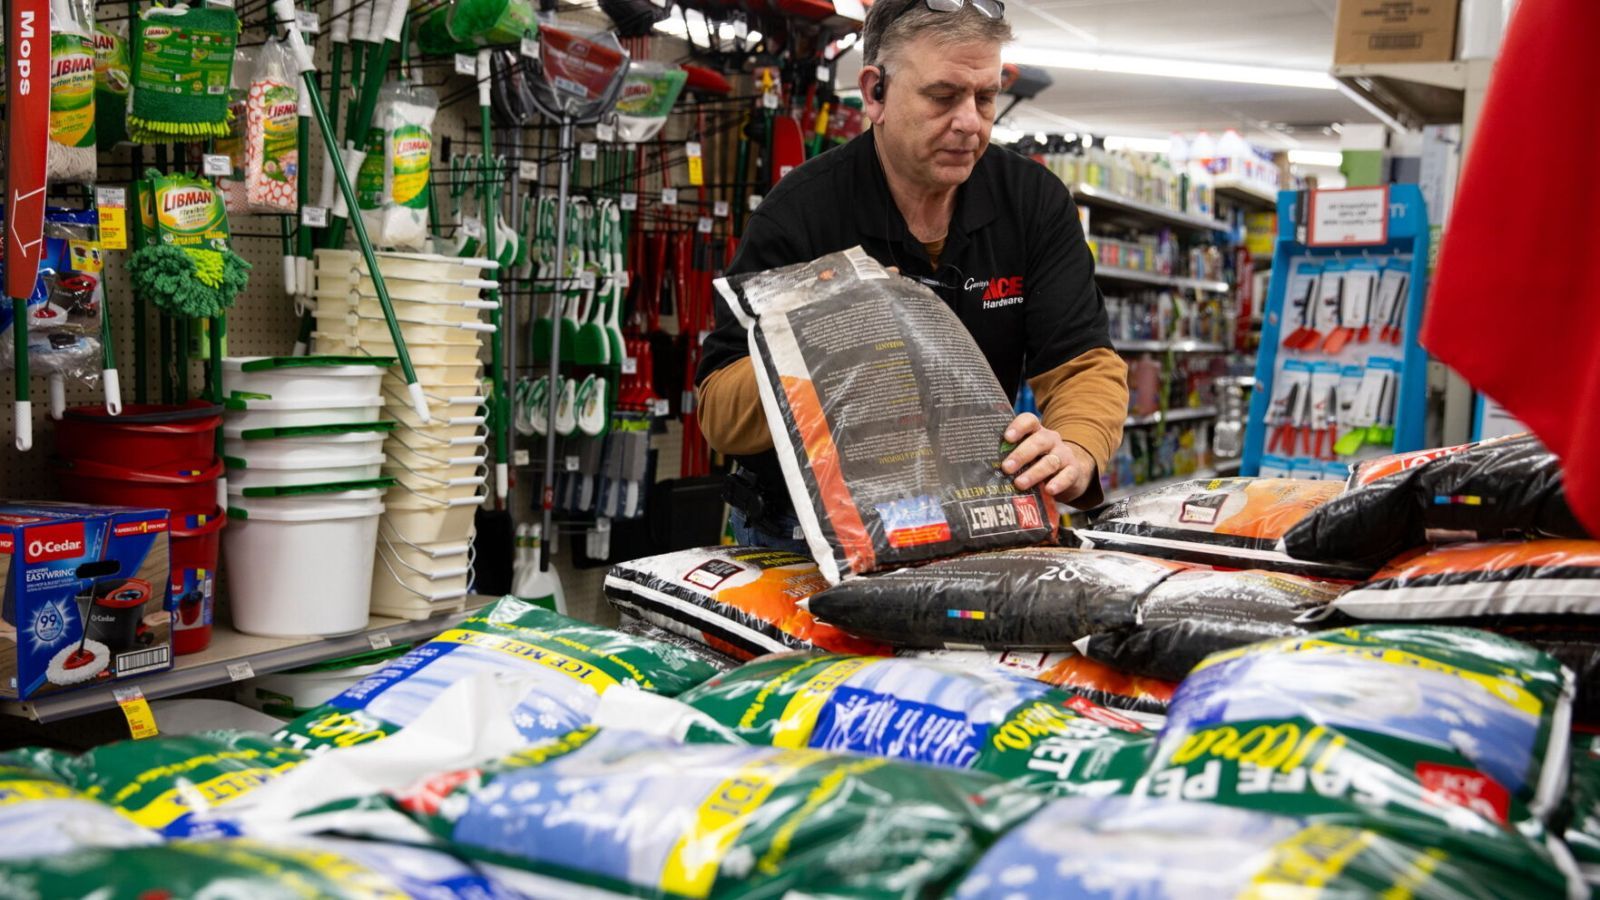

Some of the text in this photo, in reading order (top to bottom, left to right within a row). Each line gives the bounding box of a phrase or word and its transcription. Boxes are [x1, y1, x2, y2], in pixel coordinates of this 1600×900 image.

[17, 11, 35, 96] Mops
[163, 191, 212, 213] LIBMAN
[982, 275, 1024, 301] ACE
[983, 296, 1024, 310] Hardware
[969, 505, 999, 530] MELT
[997, 503, 1017, 526] ICE
[28, 540, 81, 557] O-Cedar
[26, 567, 74, 583] EASYWRING
[1232, 592, 1252, 601] On
[90, 613, 116, 622] O-Cedar
[457, 632, 594, 680] ICE MELR
[1148, 758, 1222, 802] PE
